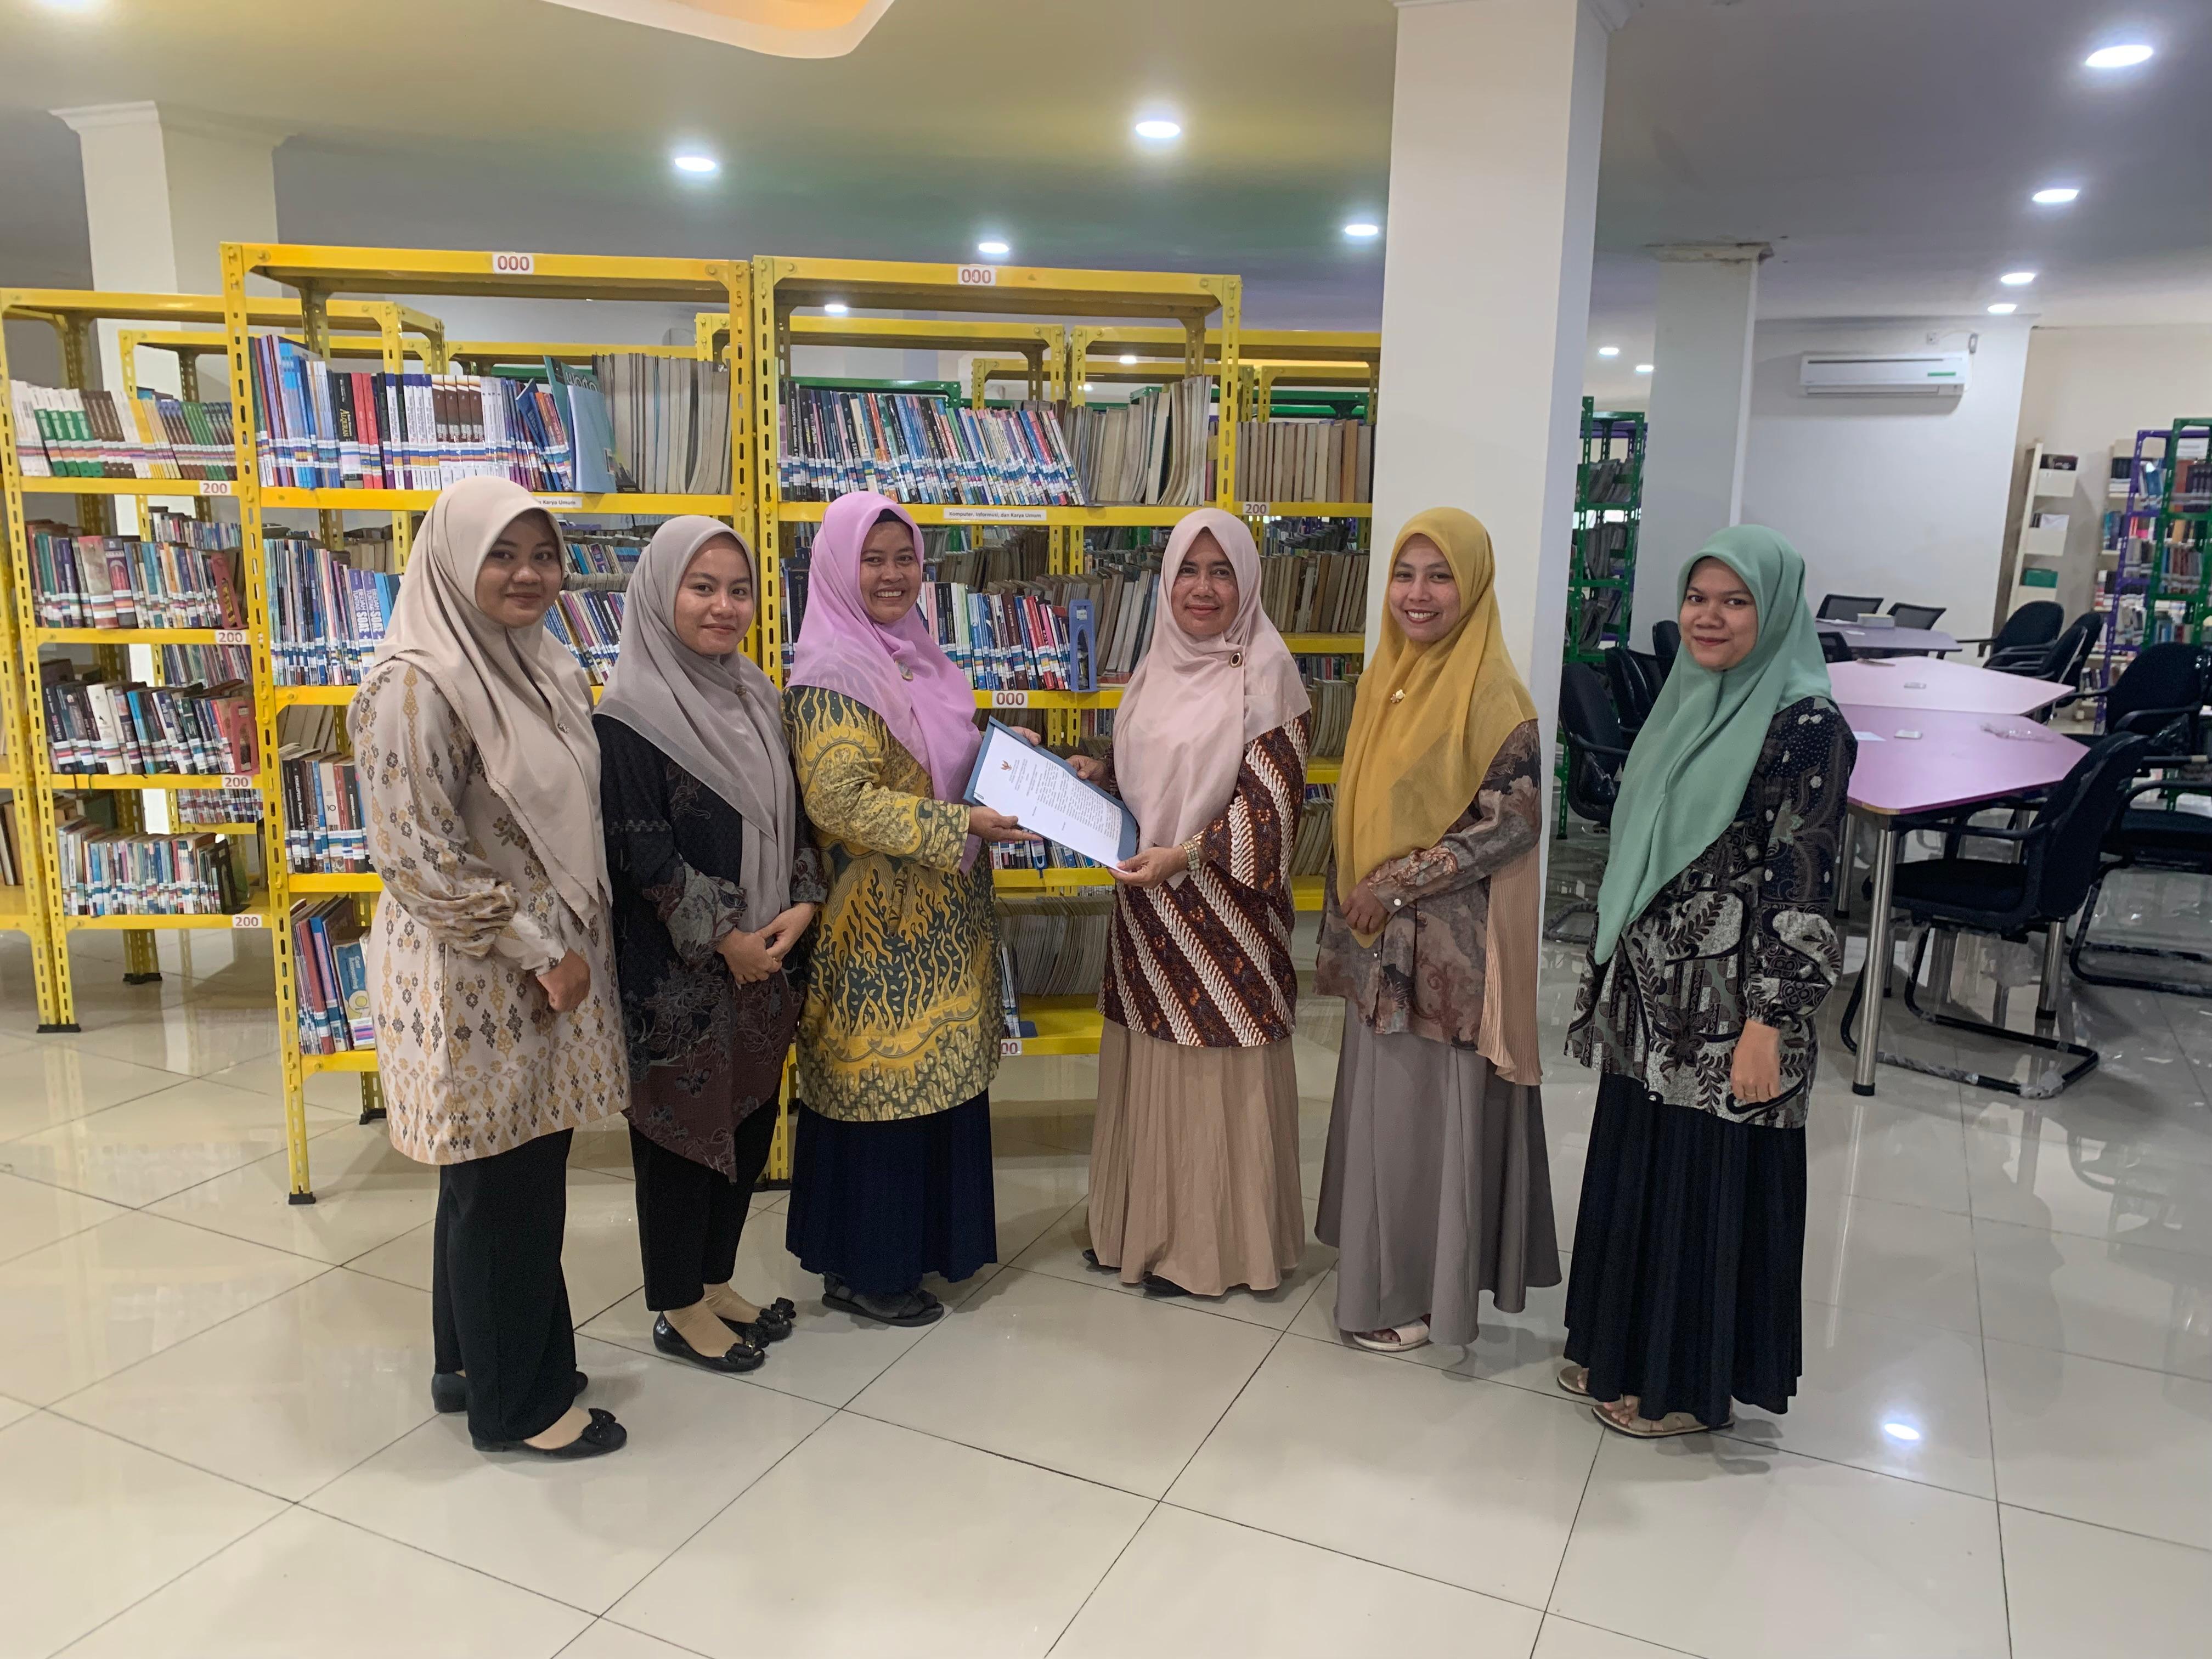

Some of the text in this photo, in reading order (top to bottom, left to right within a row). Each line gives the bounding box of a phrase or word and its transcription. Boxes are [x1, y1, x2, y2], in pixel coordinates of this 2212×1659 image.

[497, 256, 530, 271] 000
[961, 269, 992, 284] 000
[340, 408, 352, 437] ALQURAN
[203, 483, 227, 494] 200
[1245, 503, 1267, 515] 200
[358, 589, 366, 610] BEDAH
[219, 633, 242, 643] 200
[996, 692, 1025, 706] 000
[224, 777, 249, 787] 200
[235, 917, 258, 927] 200
[349, 957, 358, 990] Accounting
[1001, 1042, 1018, 1054] 00
